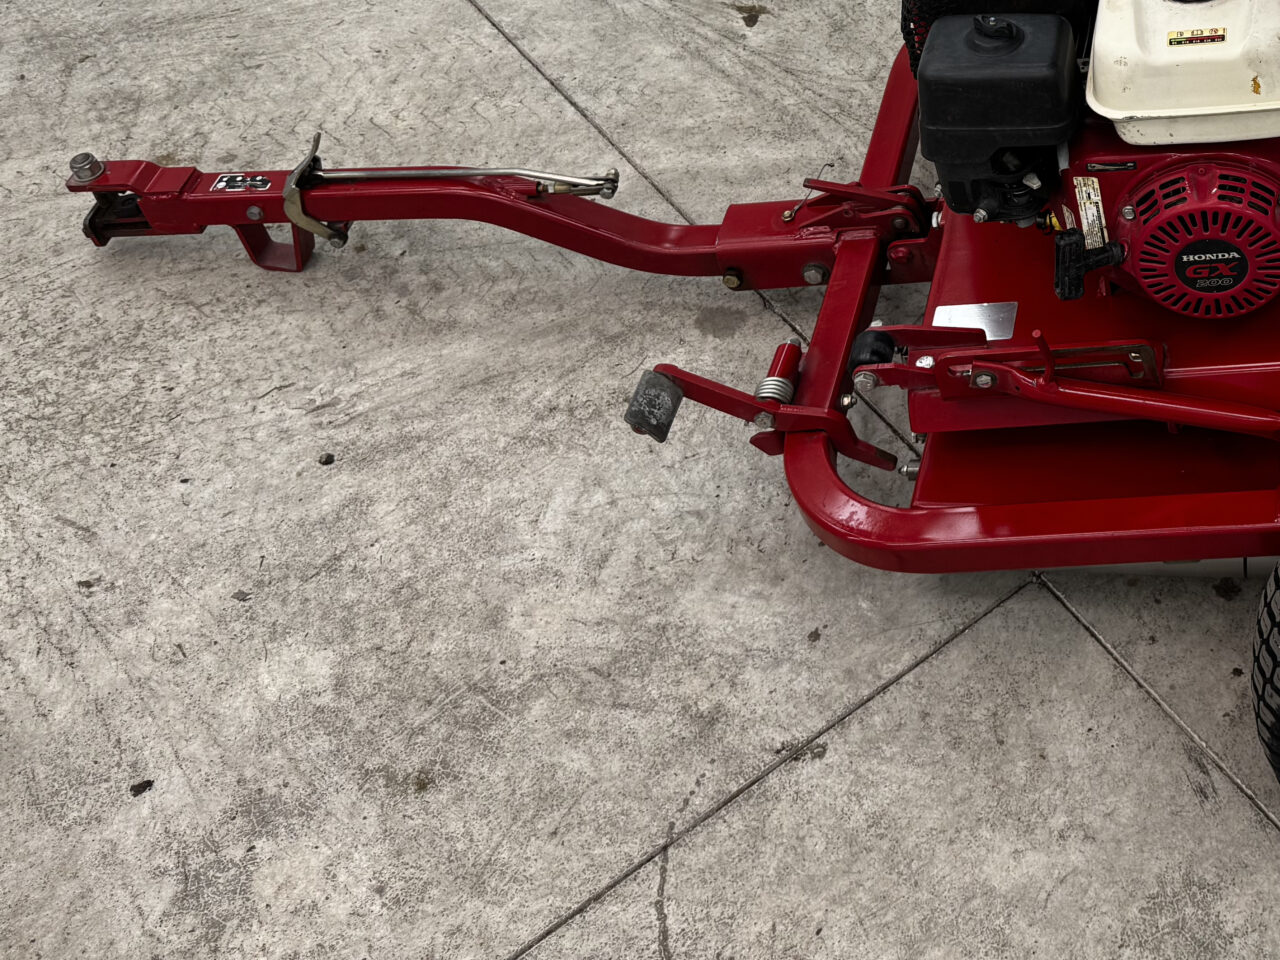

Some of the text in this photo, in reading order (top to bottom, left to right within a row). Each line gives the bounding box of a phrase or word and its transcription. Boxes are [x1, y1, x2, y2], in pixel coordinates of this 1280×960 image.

[1182, 252, 1241, 262] HONDA
[1185, 262, 1239, 278] GX
[1196, 277, 1234, 288] 200
